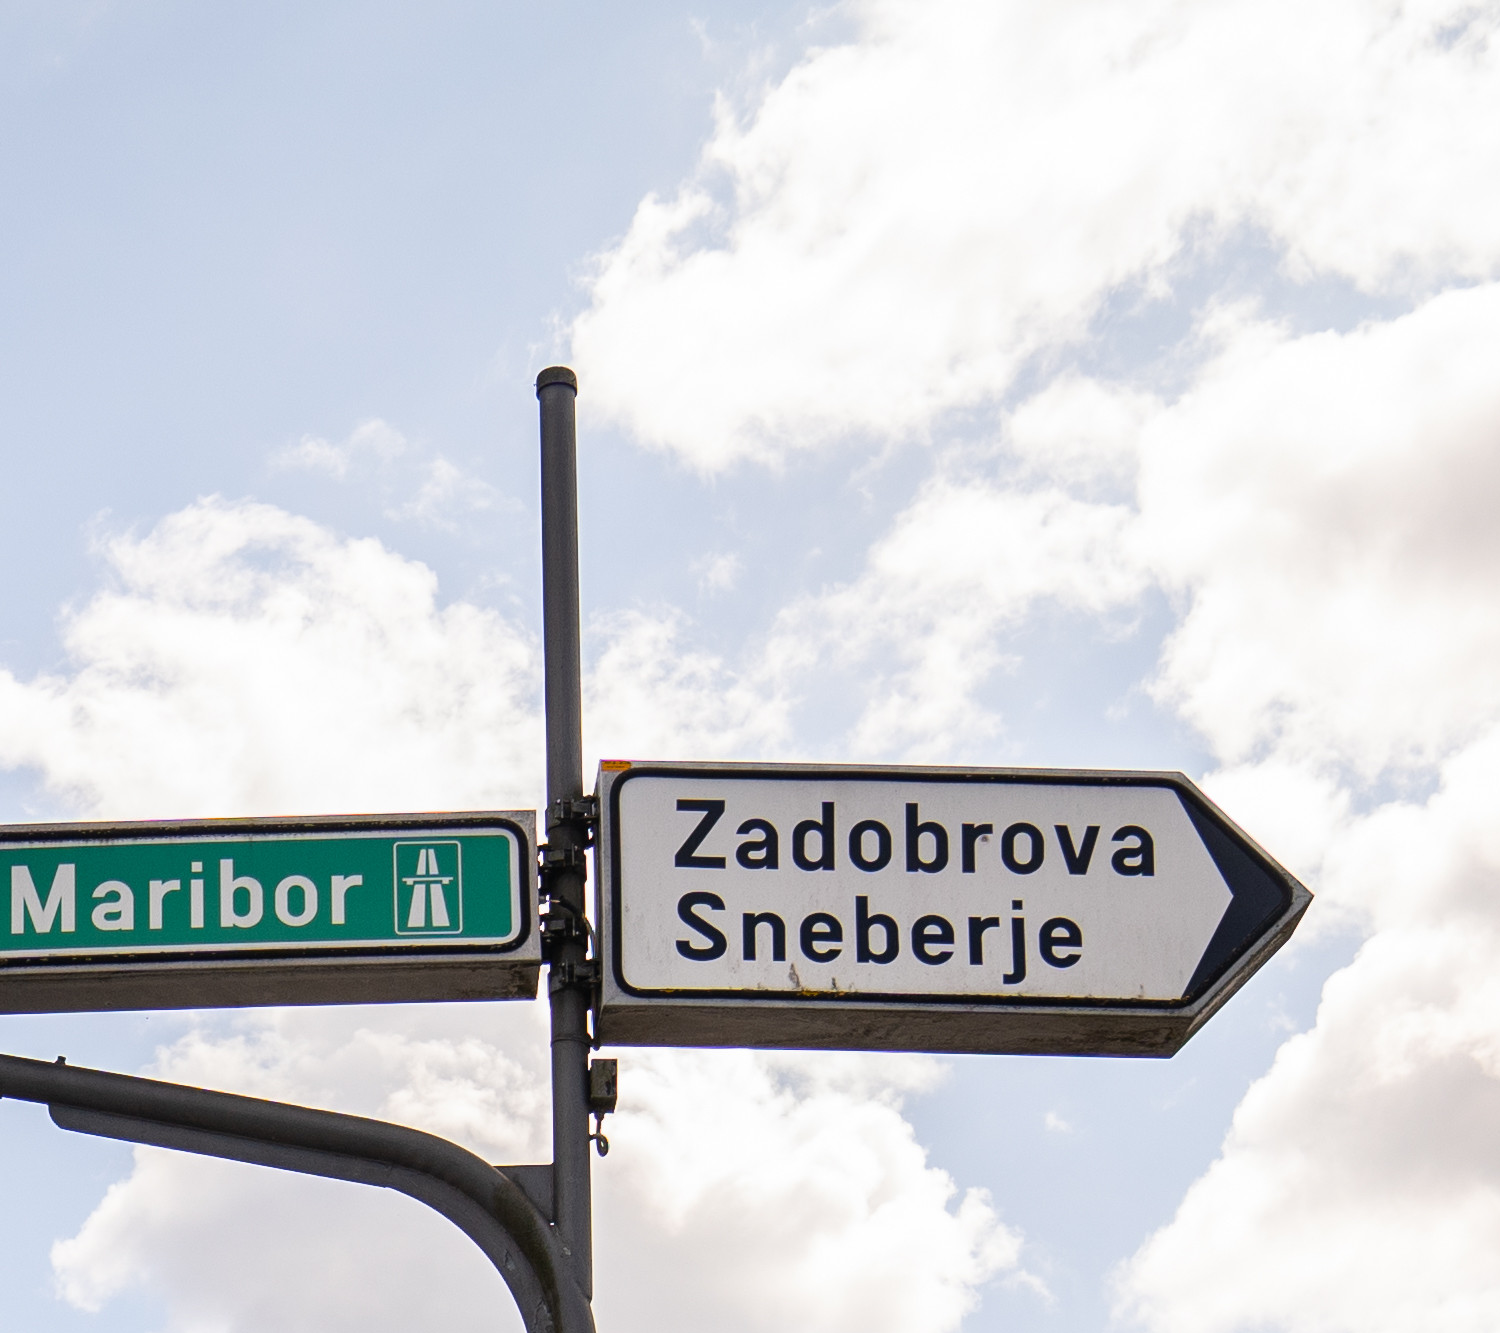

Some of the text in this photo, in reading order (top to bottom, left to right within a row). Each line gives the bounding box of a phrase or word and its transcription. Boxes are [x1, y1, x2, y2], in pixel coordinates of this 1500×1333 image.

[674, 798, 1156, 878] Zadobrova
[10, 858, 363, 935] Maribor
[674, 891, 1083, 985] Sneberje
